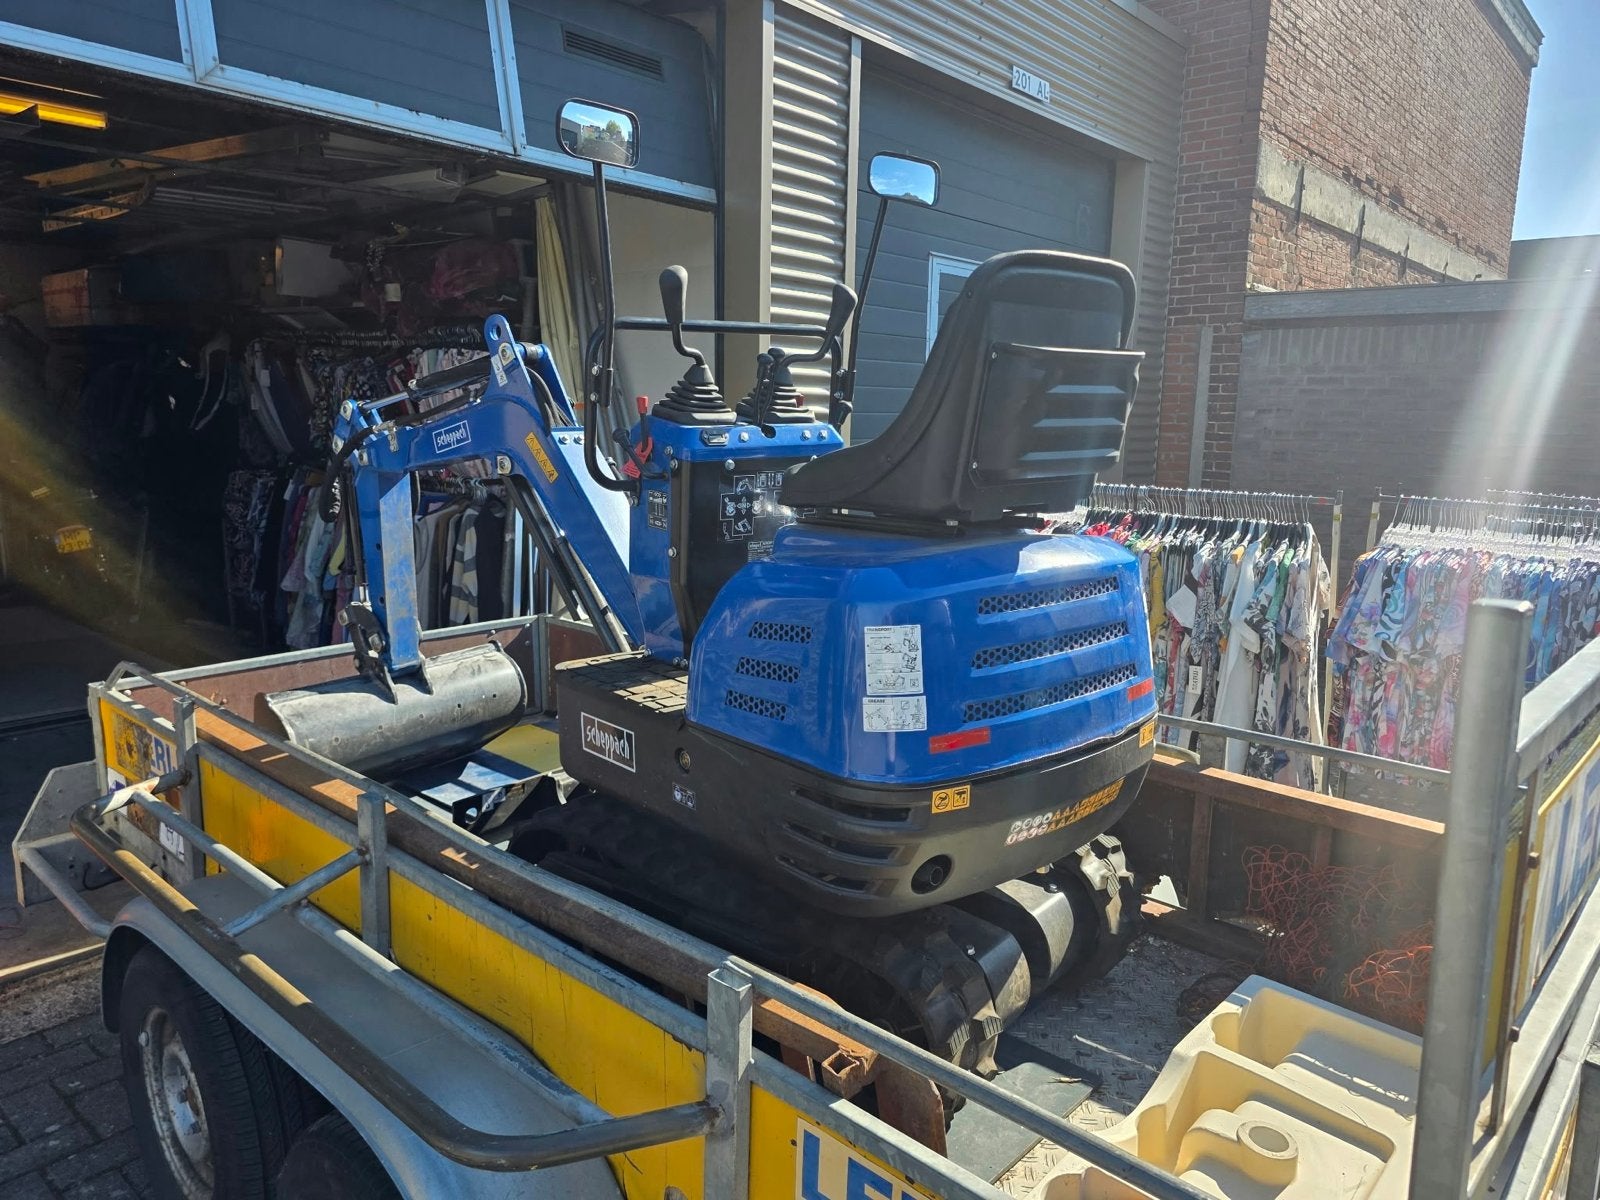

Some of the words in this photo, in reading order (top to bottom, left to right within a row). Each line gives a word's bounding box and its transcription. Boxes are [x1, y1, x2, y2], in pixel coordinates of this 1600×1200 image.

[1015, 70, 1031, 93] 201
[435, 422, 467, 448] scheppach
[586, 718, 630, 760] scheppach
